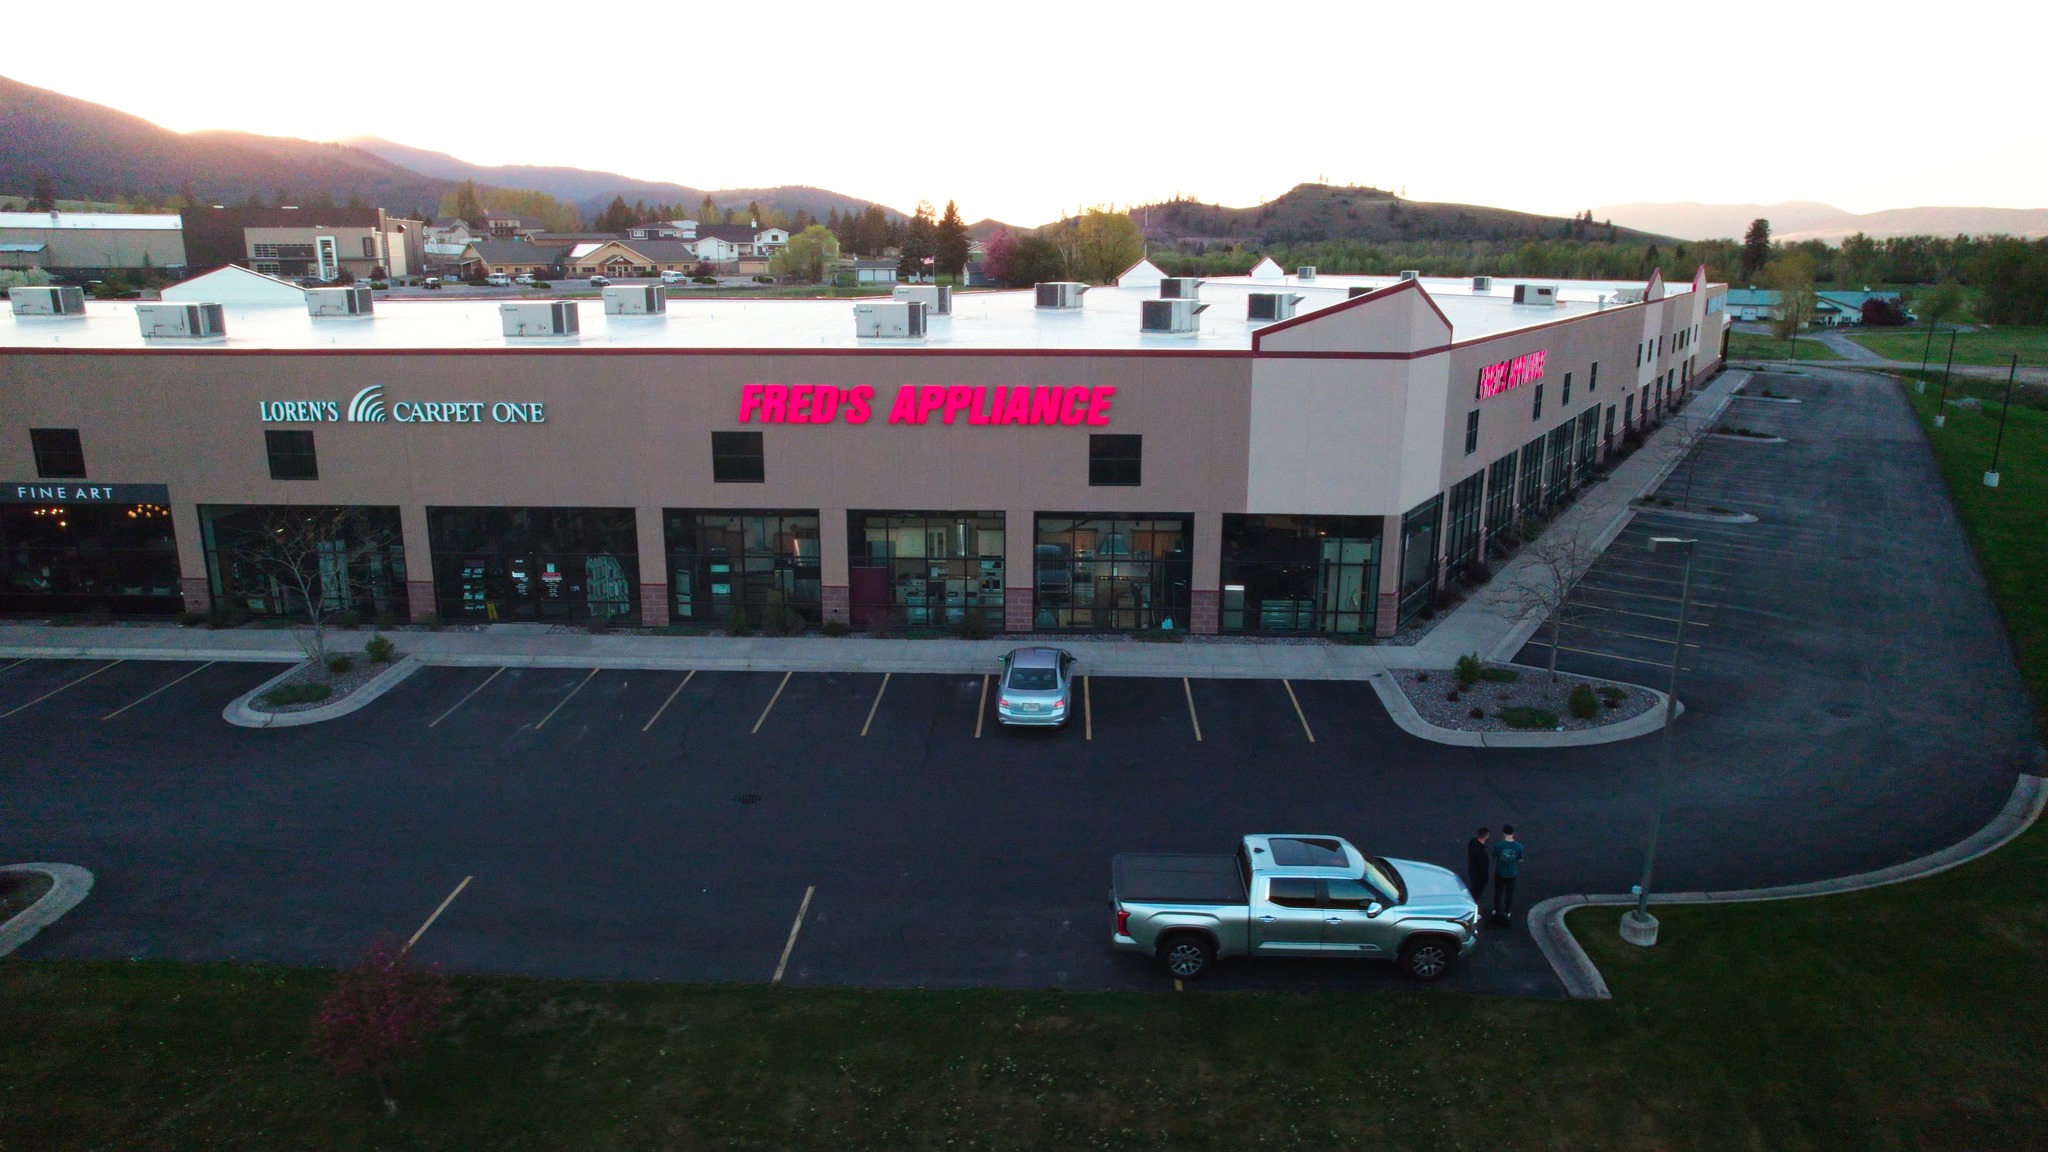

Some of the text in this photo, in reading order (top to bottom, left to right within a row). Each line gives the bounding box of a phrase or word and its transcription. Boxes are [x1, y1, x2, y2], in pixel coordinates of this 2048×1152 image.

[259, 401, 545, 423] LOREN'S CARPET ONE
[738, 383, 1116, 426] FRED'S APPLIANCE
[17, 486, 112, 499] FINE ART
